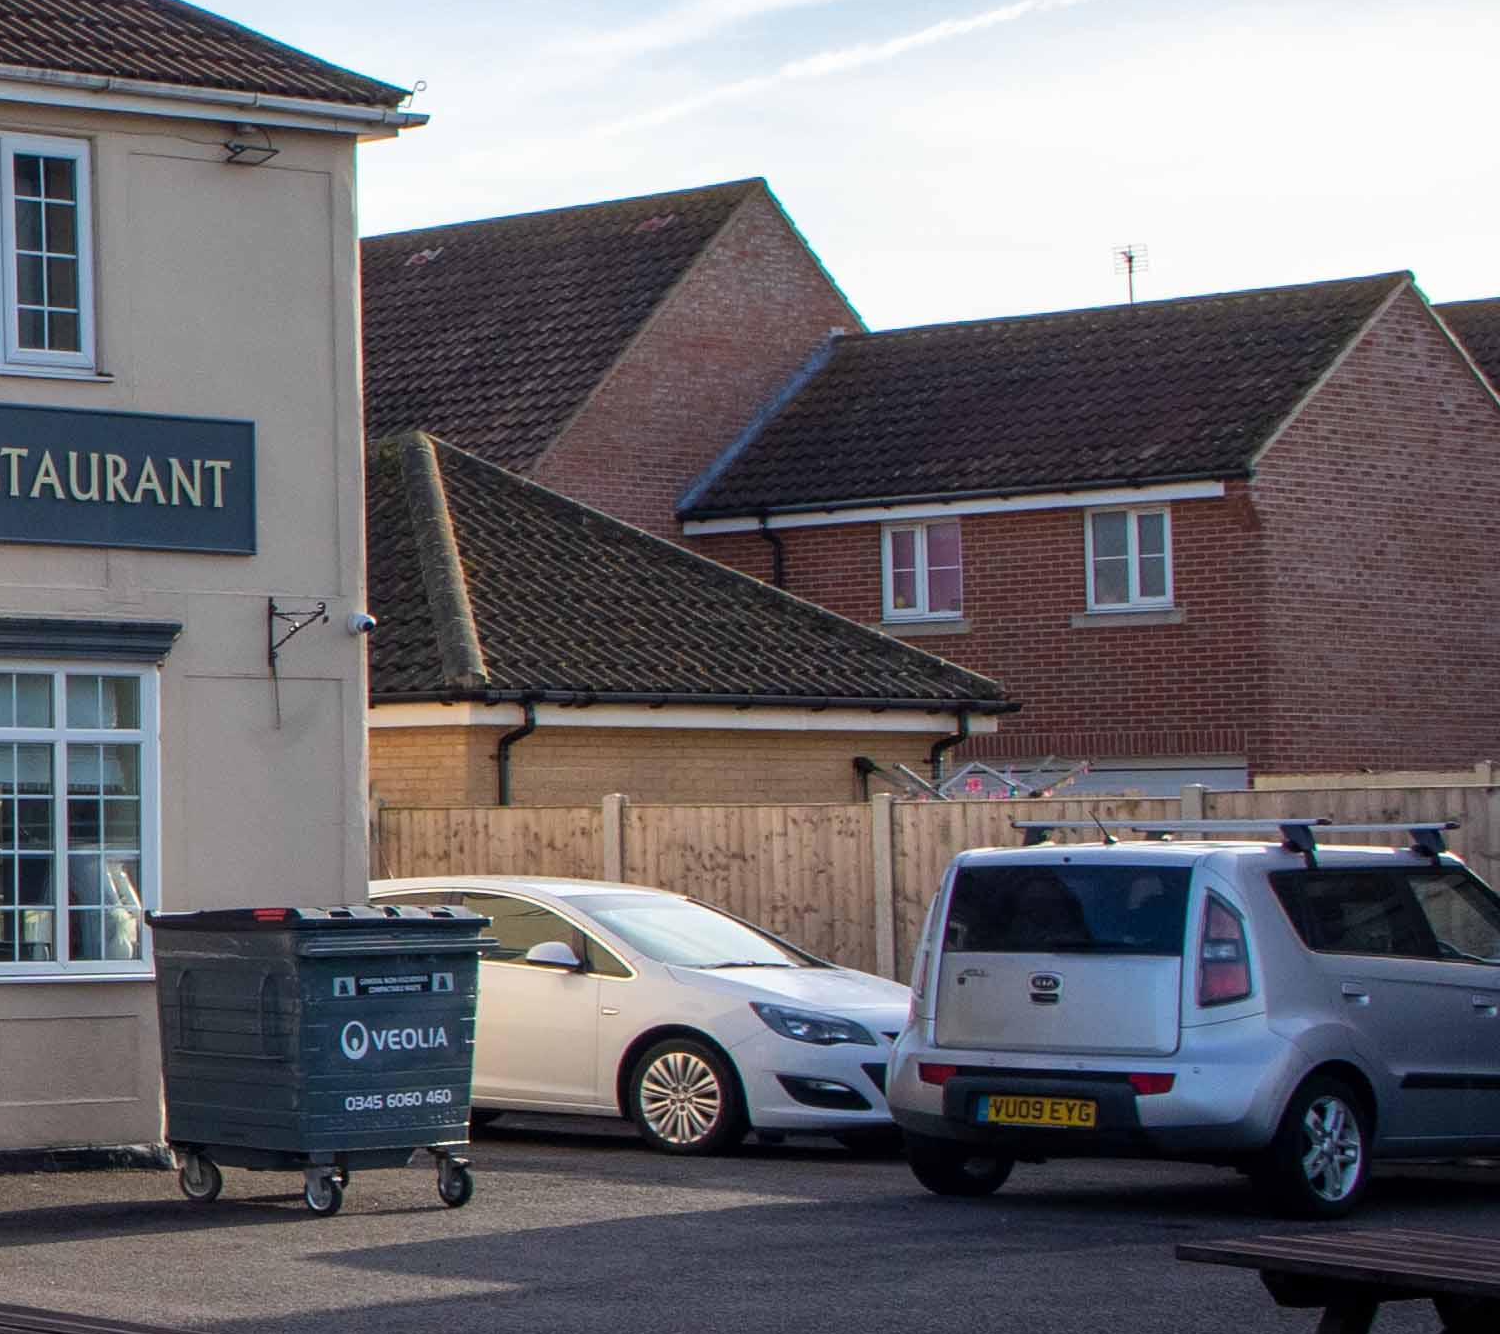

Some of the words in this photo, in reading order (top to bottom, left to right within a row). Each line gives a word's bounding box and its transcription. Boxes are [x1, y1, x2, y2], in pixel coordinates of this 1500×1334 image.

[371, 1027, 448, 1050] VEOLIA
[345, 1094, 383, 1111] 0345
[386, 1091, 422, 1107] 6060
[426, 1088, 453, 1104] 460
[991, 1098, 1043, 1120] VU09
[1051, 1101, 1092, 1123] EYG
